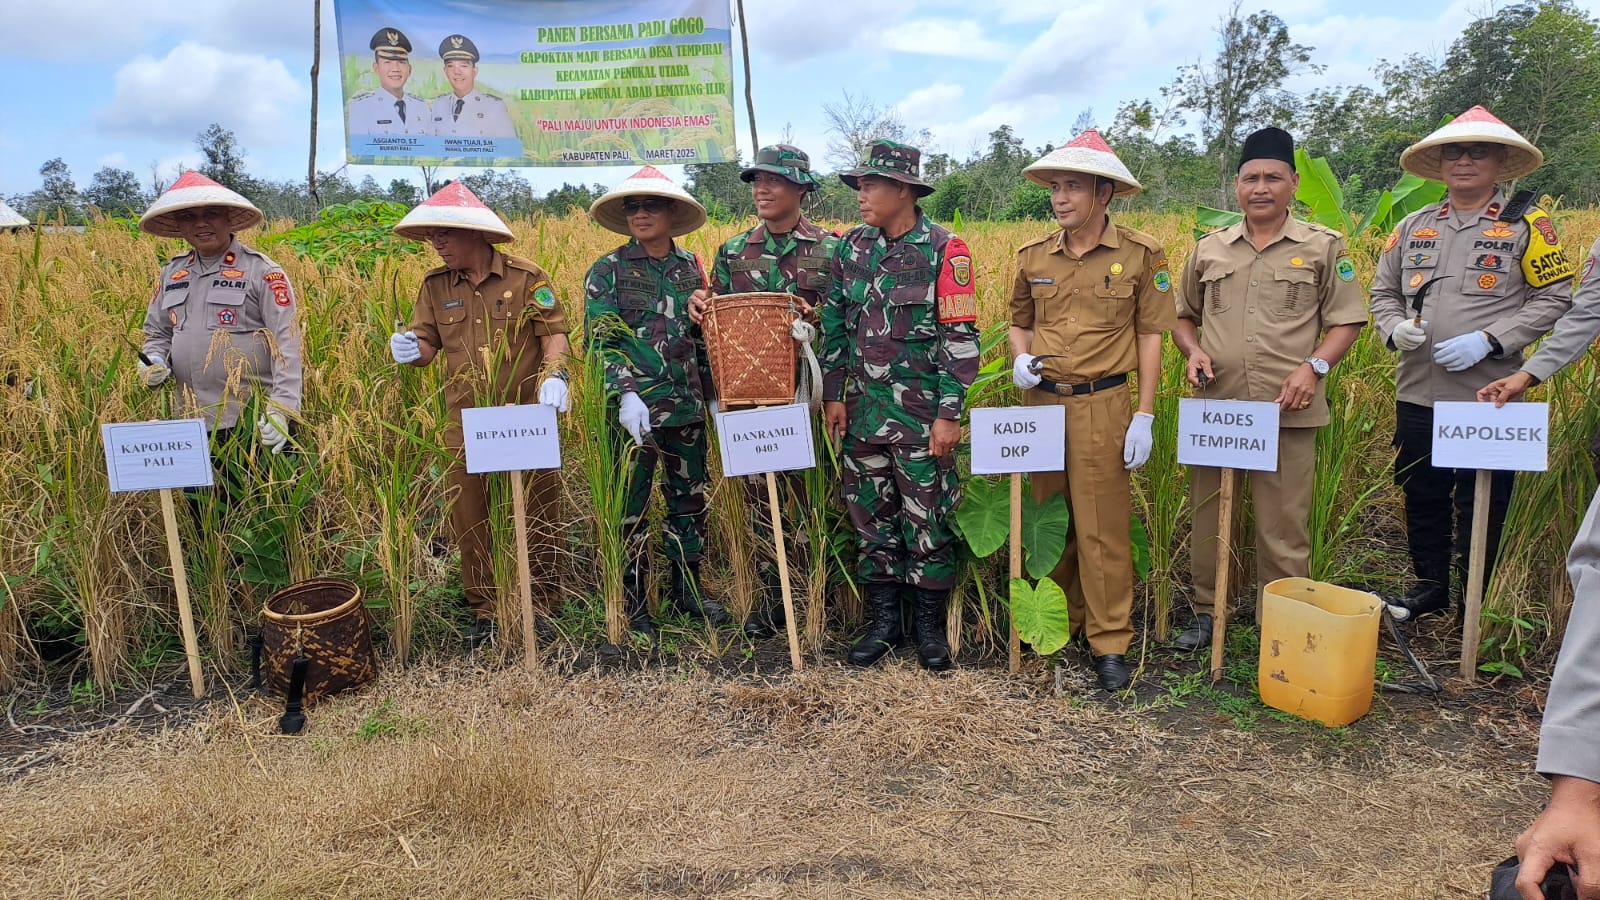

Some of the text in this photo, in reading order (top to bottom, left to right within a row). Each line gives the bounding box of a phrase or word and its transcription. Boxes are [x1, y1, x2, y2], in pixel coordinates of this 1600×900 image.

[537, 17, 704, 43] PANEN BERSAMA PADI GOGO
[521, 43, 723, 64] GAPOKTAN MAJU BERSAMA DESA TEMPIRAI
[556, 64, 690, 82] KECAMATAN PENUKAL UTARA
[521, 82, 725, 101] KABUPATEN PENUKAL ABAB LEMATANG ILIR
[564, 118, 592, 131] MAJU
[594, 118, 627, 130] UNTUK
[630, 116, 681, 129] INDONESIA
[562, 151, 611, 161] KABUPATEN
[646, 149, 673, 160] MARET
[676, 148, 695, 158] 2025
[1409, 241, 1436, 249] BUDI
[1474, 240, 1514, 251] POLRI
[1530, 250, 1568, 274] SATGA
[1537, 264, 1570, 282] PENUKA
[213, 280, 246, 289] POLRI
[937, 294, 976, 319] BABIN
[1202, 411, 1254, 427] KADES
[476, 427, 547, 440] BUPATI PALI
[732, 426, 798, 443] DANRAMIL
[993, 421, 1037, 435] KADIS
[1438, 425, 1542, 442] KAPOLSEK
[121, 440, 193, 454] KAPOLRES
[755, 443, 779, 454] 0403
[1189, 433, 1266, 452] TEMPIRAI
[1001, 445, 1030, 458] DKP
[144, 456, 175, 467] PALI
